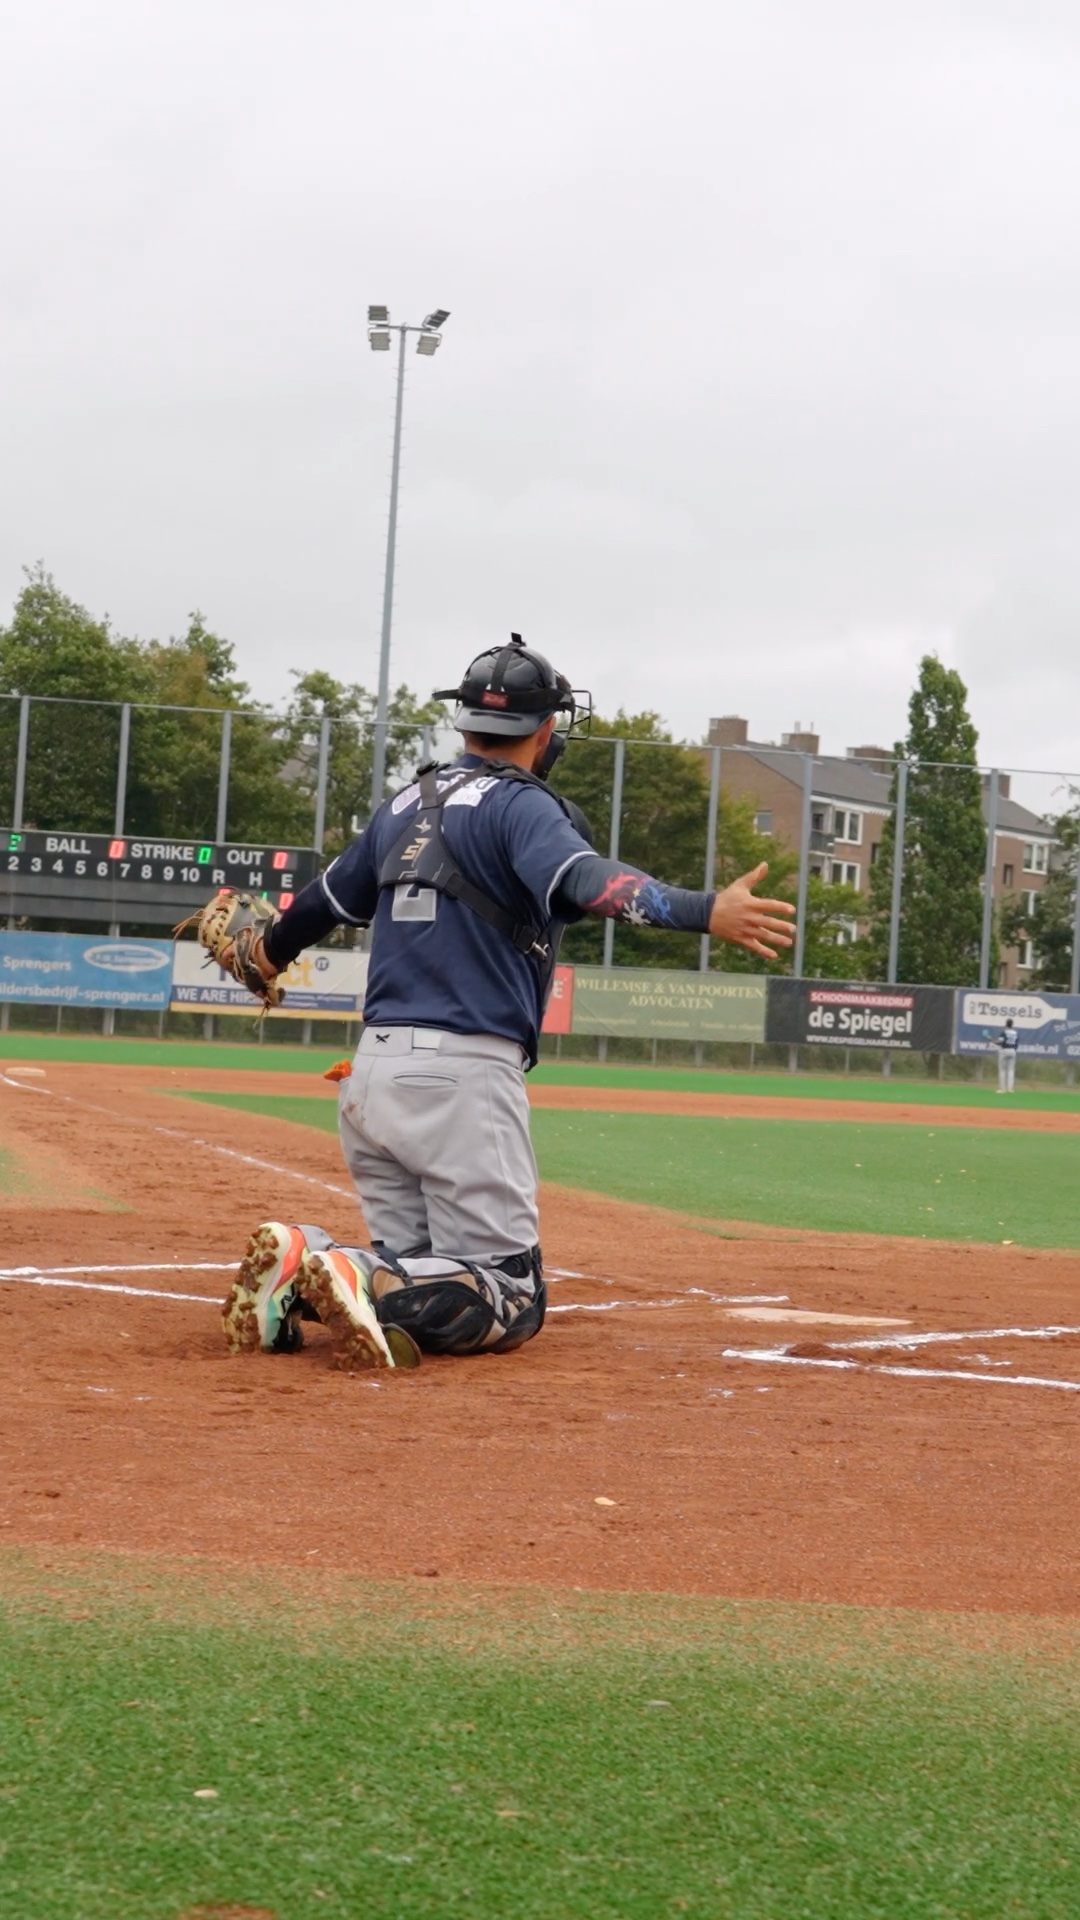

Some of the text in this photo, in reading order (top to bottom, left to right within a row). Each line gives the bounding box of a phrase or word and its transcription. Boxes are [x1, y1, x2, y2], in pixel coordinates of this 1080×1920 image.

[45, 837, 91, 854] BALL
[131, 843, 195, 861] STRIKE
[198, 847, 212, 864] 0
[226, 849, 264, 865] OUT
[273, 851, 288, 870] 0
[8, 856, 293, 888] 2 3 4 5 6 7 8 9 10 R H E
[2, 955, 72, 973] Sprengers
[176, 987, 199, 999] WE
[200, 989, 227, 1002] ARE
[576, 978, 651, 994] WILLEMSE
[653, 982, 665, 994] &
[668, 983, 696, 995] VAN
[698, 985, 764, 999] POORTEN
[628, 995, 713, 1009] ADVOCATEN
[978, 1002, 1043, 1019] Tessels
[808, 1005, 912, 1038] de Spiegel
